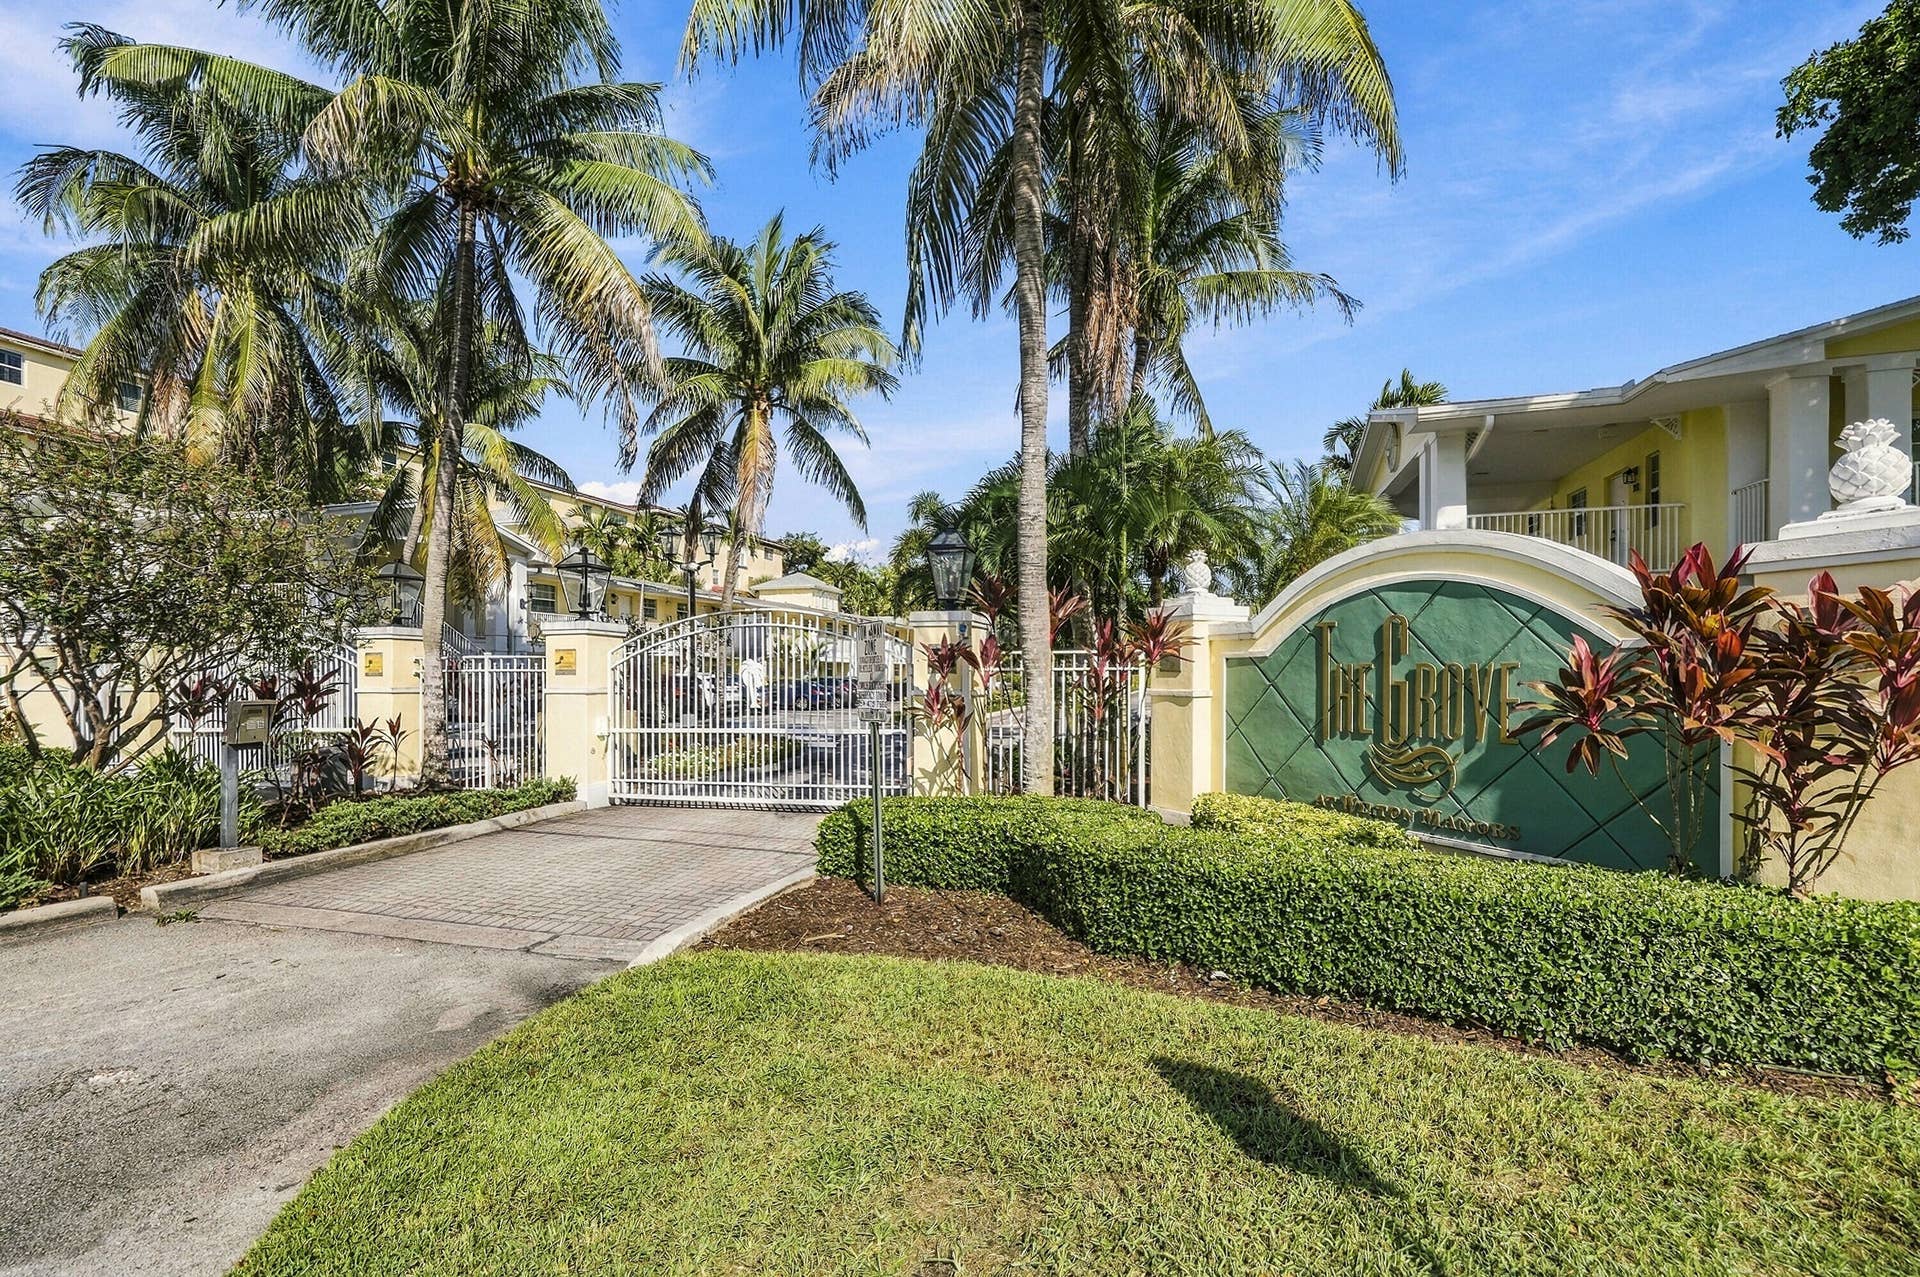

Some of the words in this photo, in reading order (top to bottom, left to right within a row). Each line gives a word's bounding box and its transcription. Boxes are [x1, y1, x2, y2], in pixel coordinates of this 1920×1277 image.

[864, 639, 877, 656] ZONE
[1315, 620, 1375, 741] THE
[1382, 613, 1521, 745] GROVE
[1420, 807, 1521, 841] MANORS
